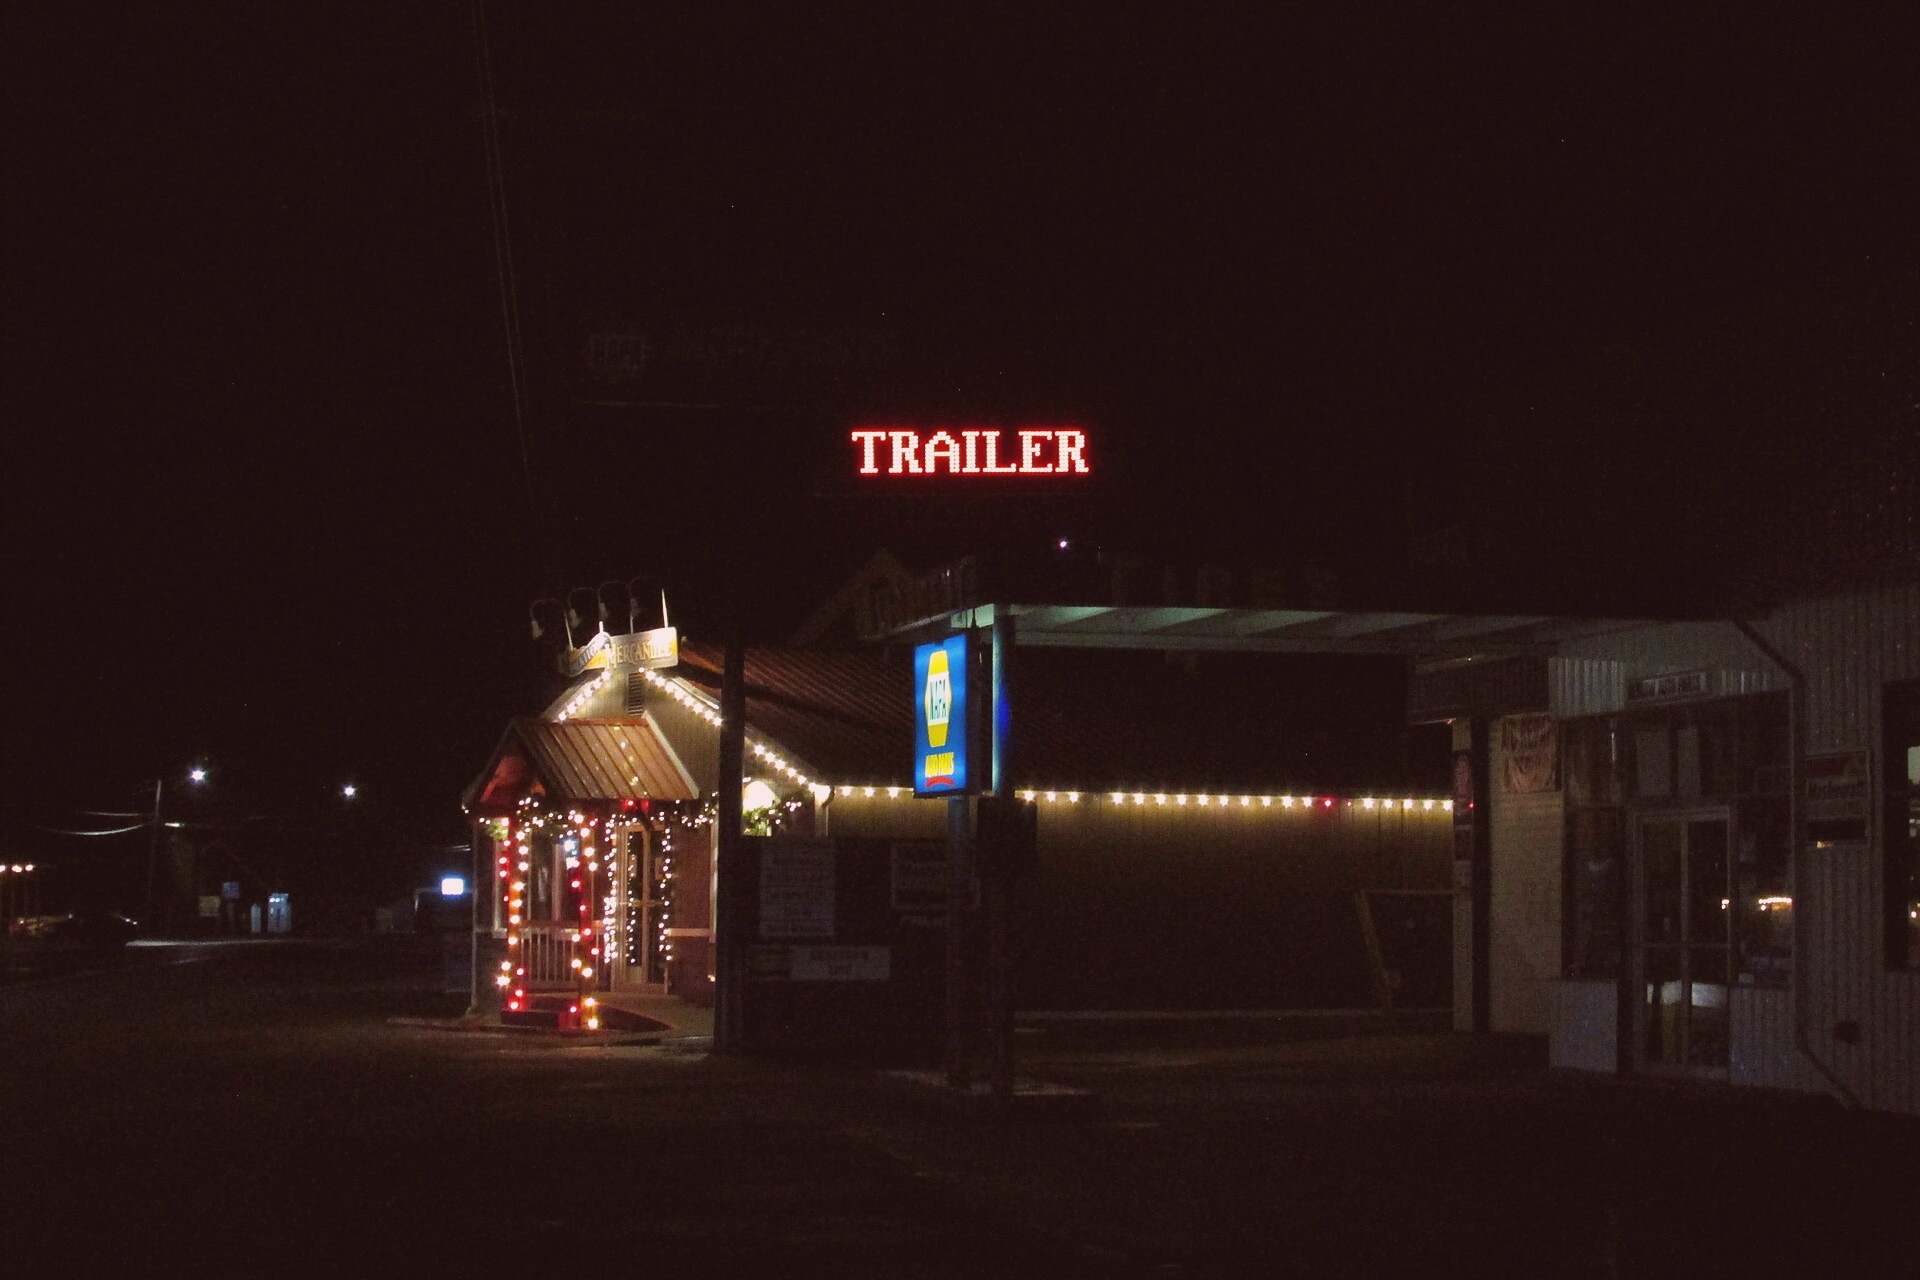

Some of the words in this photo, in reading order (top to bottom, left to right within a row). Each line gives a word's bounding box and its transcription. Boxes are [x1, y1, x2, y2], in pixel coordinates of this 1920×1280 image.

[851, 430, 1089, 473] TRAILER
[604, 640, 673, 669] MERCANTI
[929, 679, 947, 720] NAPA
